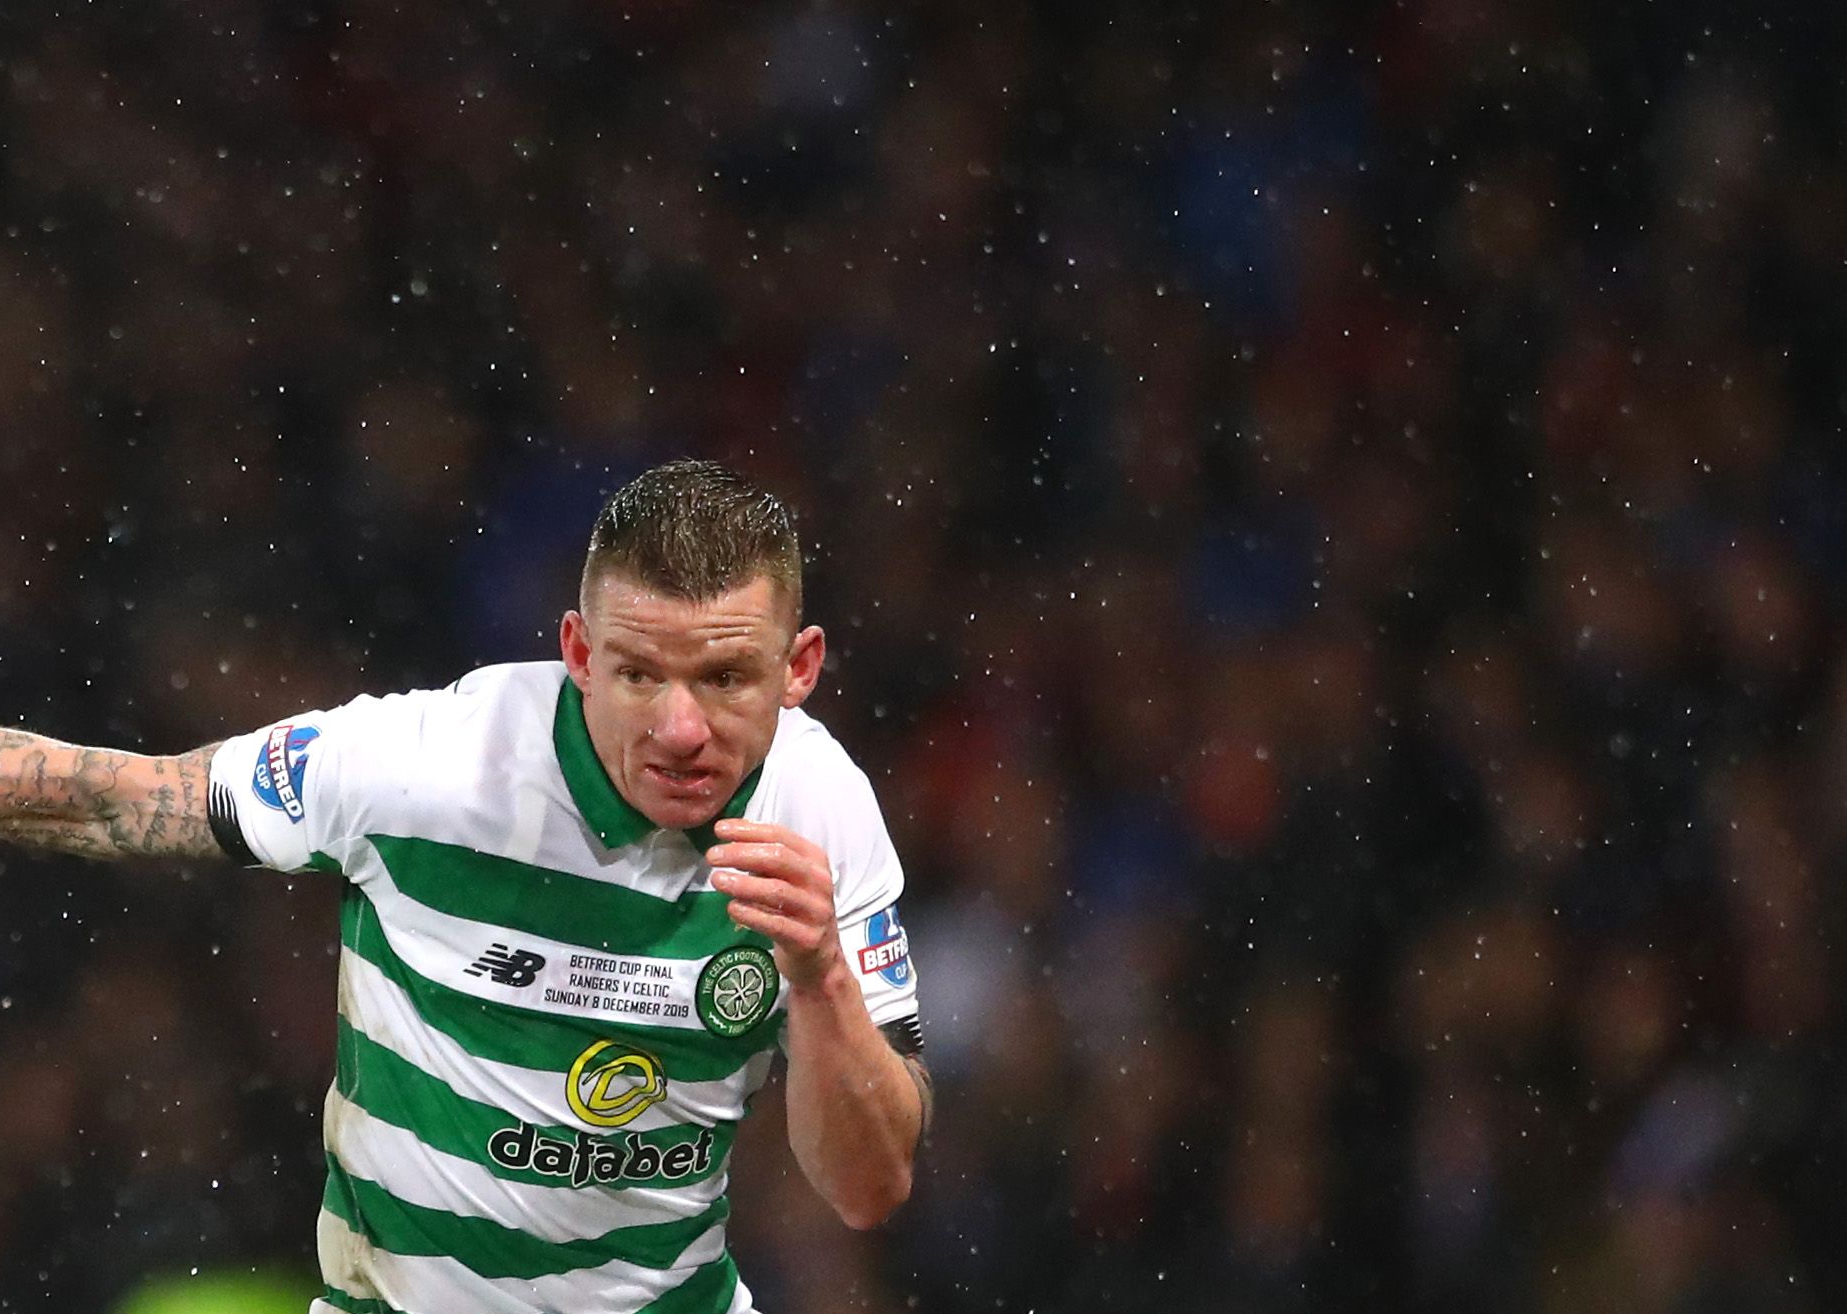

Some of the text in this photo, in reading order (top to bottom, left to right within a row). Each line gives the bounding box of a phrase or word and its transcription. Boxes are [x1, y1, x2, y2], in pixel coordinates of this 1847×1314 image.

[256, 763, 271, 790] CUP
[269, 726, 304, 818] BETFRED
[569, 954, 674, 980] BETFRED CUP FINAL
[569, 974, 670, 998] RANGERS V CELTIC
[544, 989, 689, 1018] SUNDAY 8 DECEMBER 2019
[488, 1120, 714, 1188] dafabet
